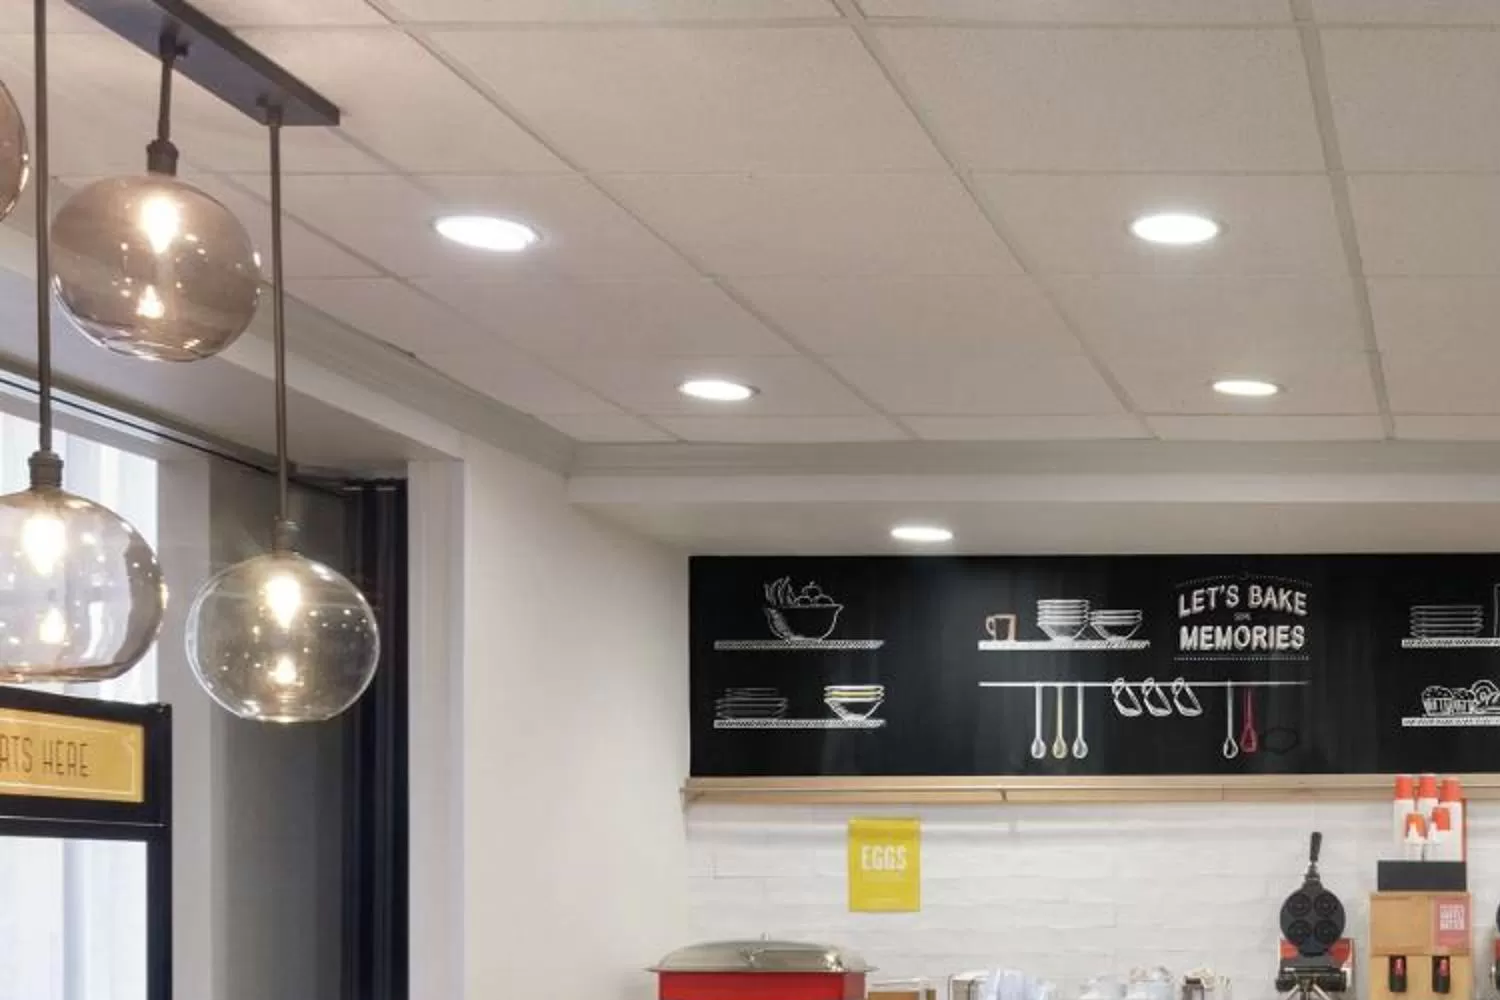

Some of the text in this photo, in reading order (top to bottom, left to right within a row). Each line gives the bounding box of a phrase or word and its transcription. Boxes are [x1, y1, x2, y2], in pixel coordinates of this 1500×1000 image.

[1178, 584, 1308, 618] LET'S BAKE
[1180, 625, 1305, 650] MEMORIES
[42, 739, 90, 778] HERE
[861, 844, 908, 870] EGGS
